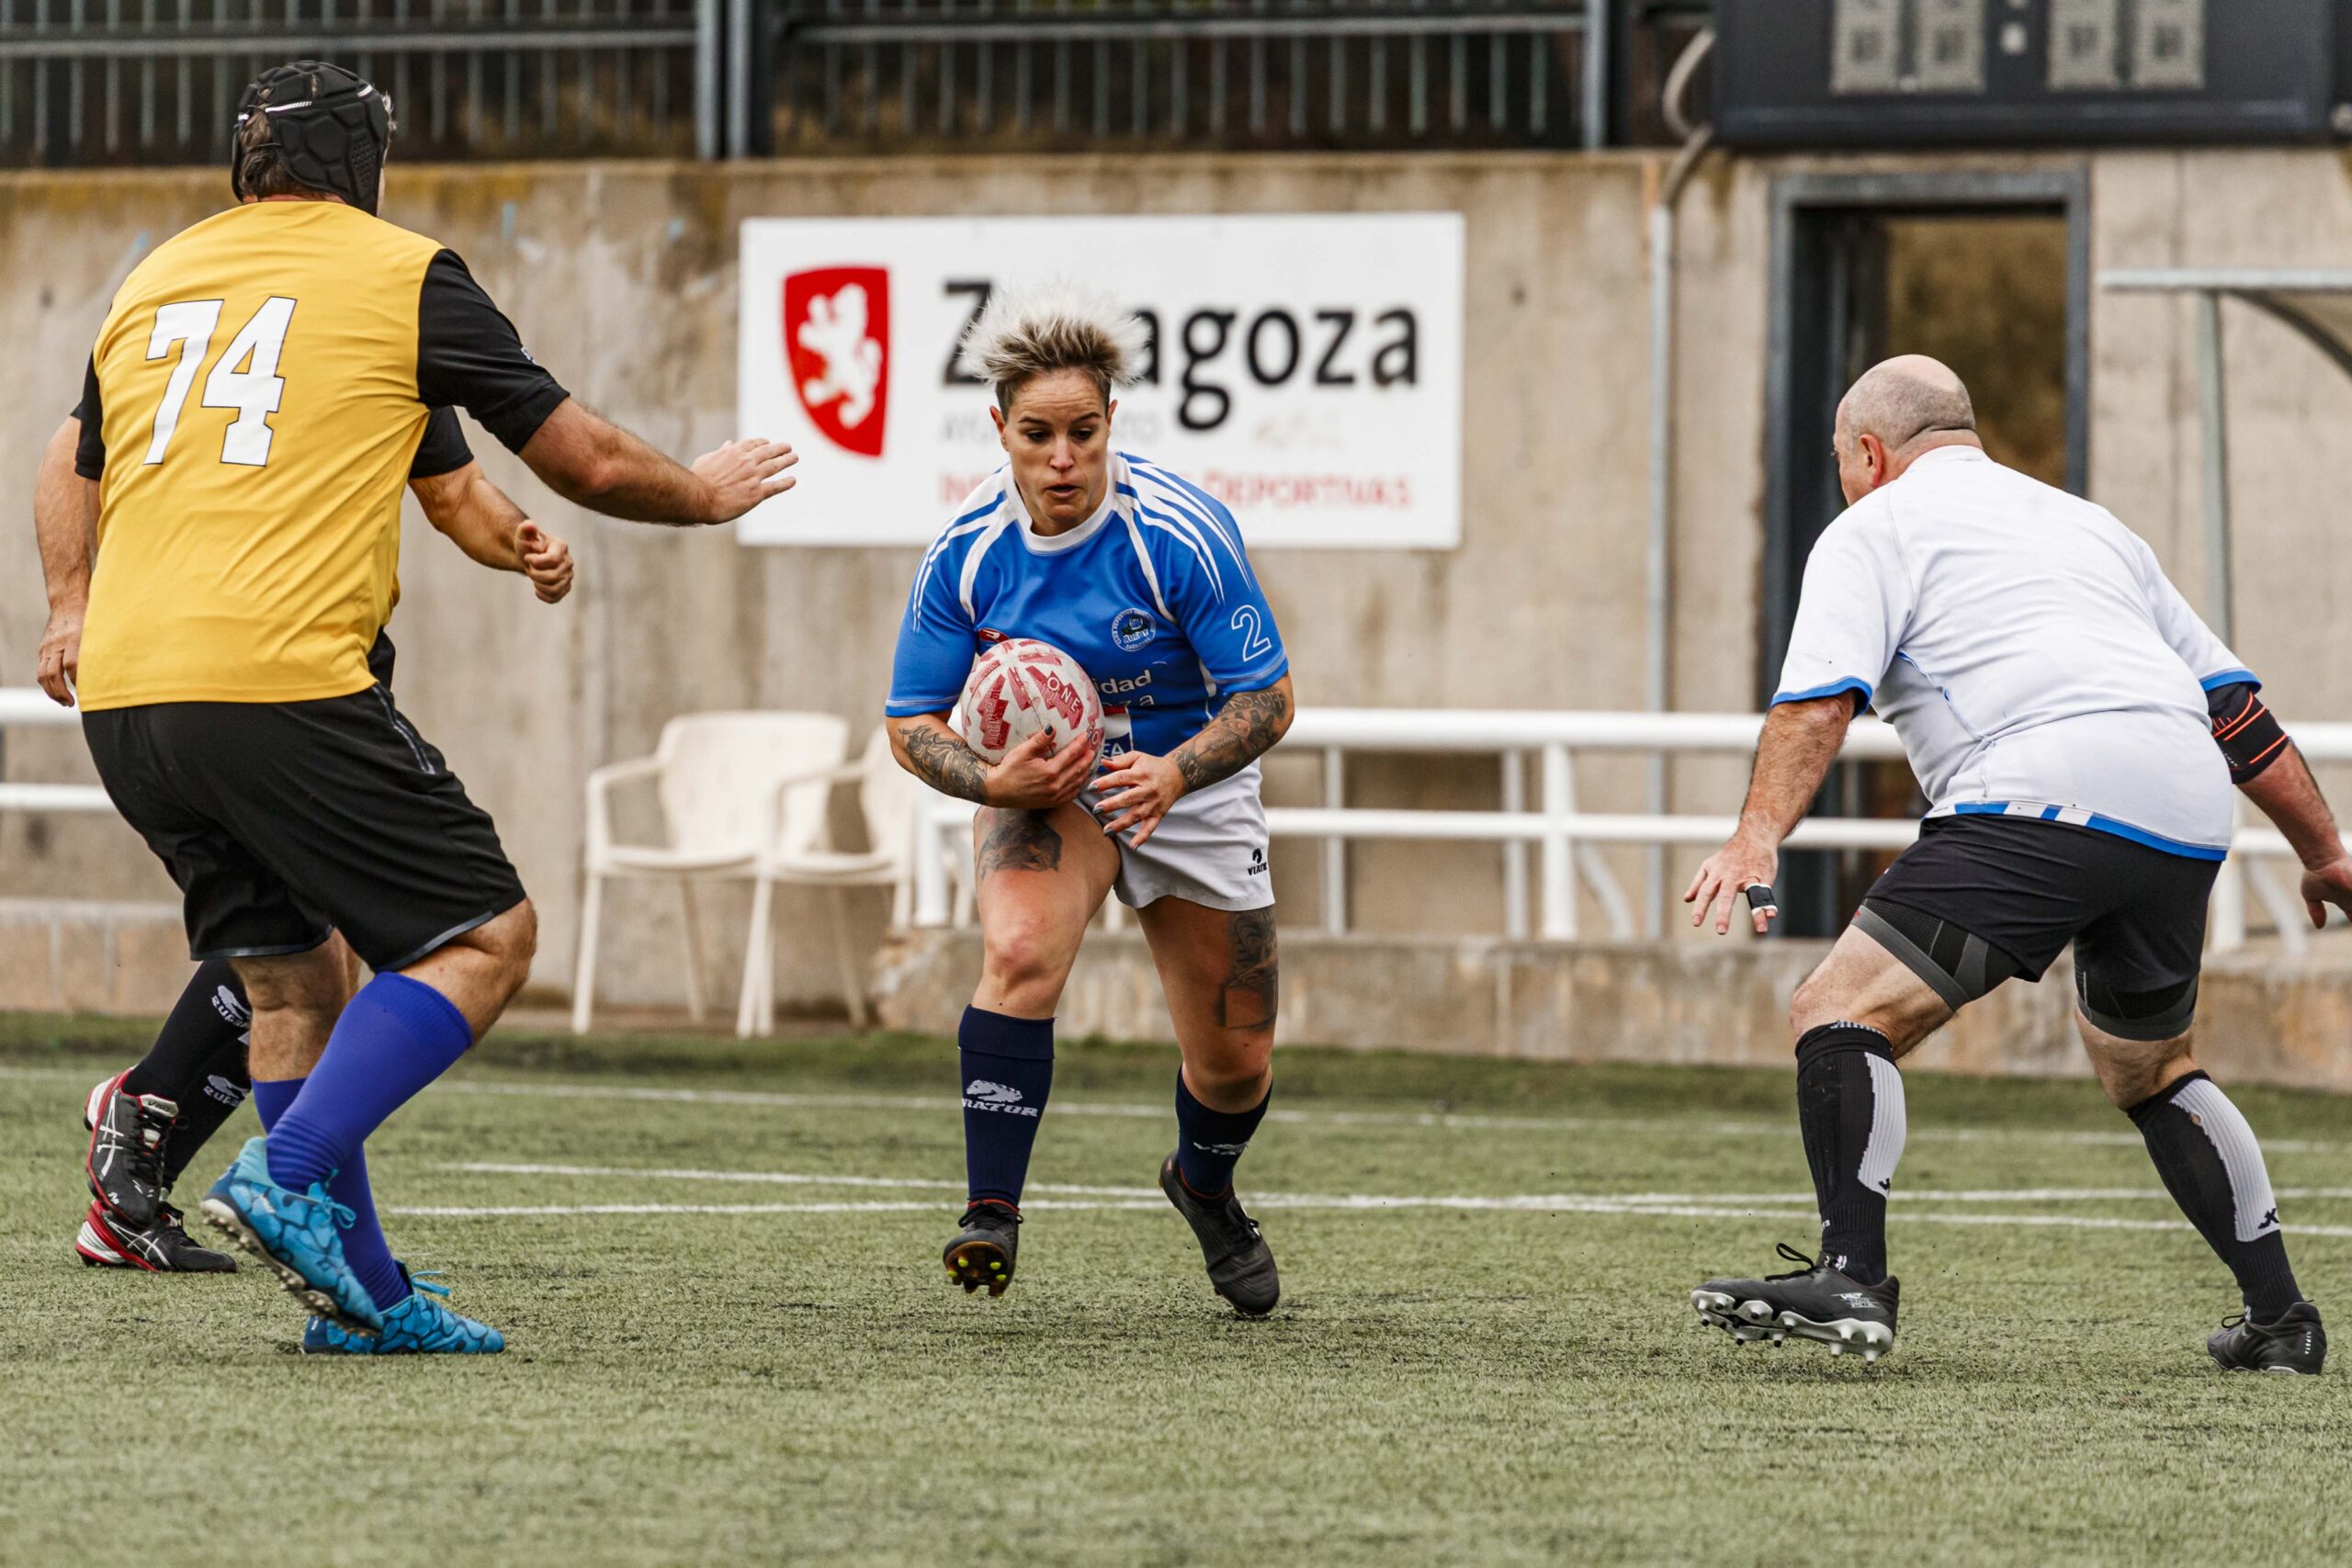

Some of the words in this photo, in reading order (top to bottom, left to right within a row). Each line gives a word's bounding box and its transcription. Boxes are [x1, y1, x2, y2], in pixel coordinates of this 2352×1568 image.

[143, 296, 298, 468] 74
[943, 279, 1418, 432] Zagoza
[1231, 604, 1272, 662] 2
[1047, 676, 1080, 714] ONE
